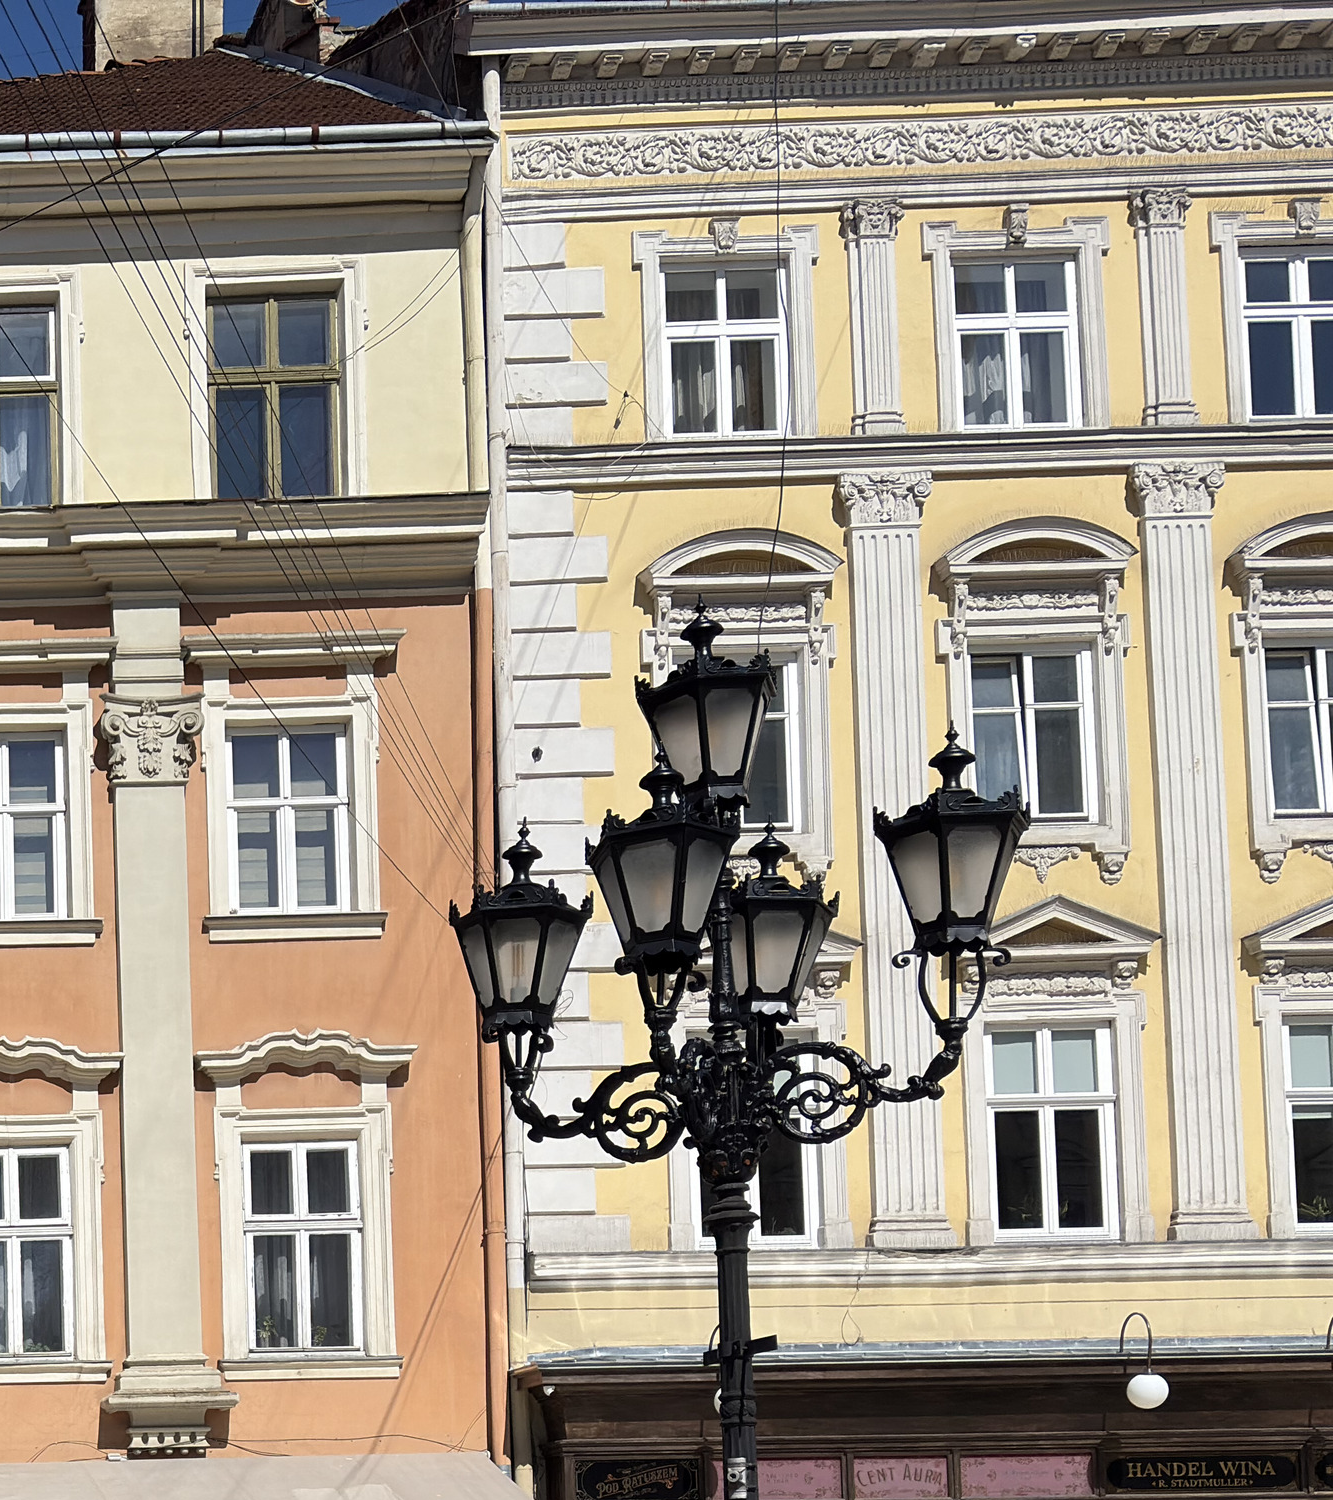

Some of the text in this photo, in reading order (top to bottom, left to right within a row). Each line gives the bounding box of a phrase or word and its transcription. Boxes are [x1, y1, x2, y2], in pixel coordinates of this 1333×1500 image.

[856, 1467, 895, 1487] CENT
[1127, 1460, 1276, 1478] HANDEL WINA
[595, 1482, 619, 1499] POD
[1158, 1478, 1248, 1488] R. STADTMULLER
